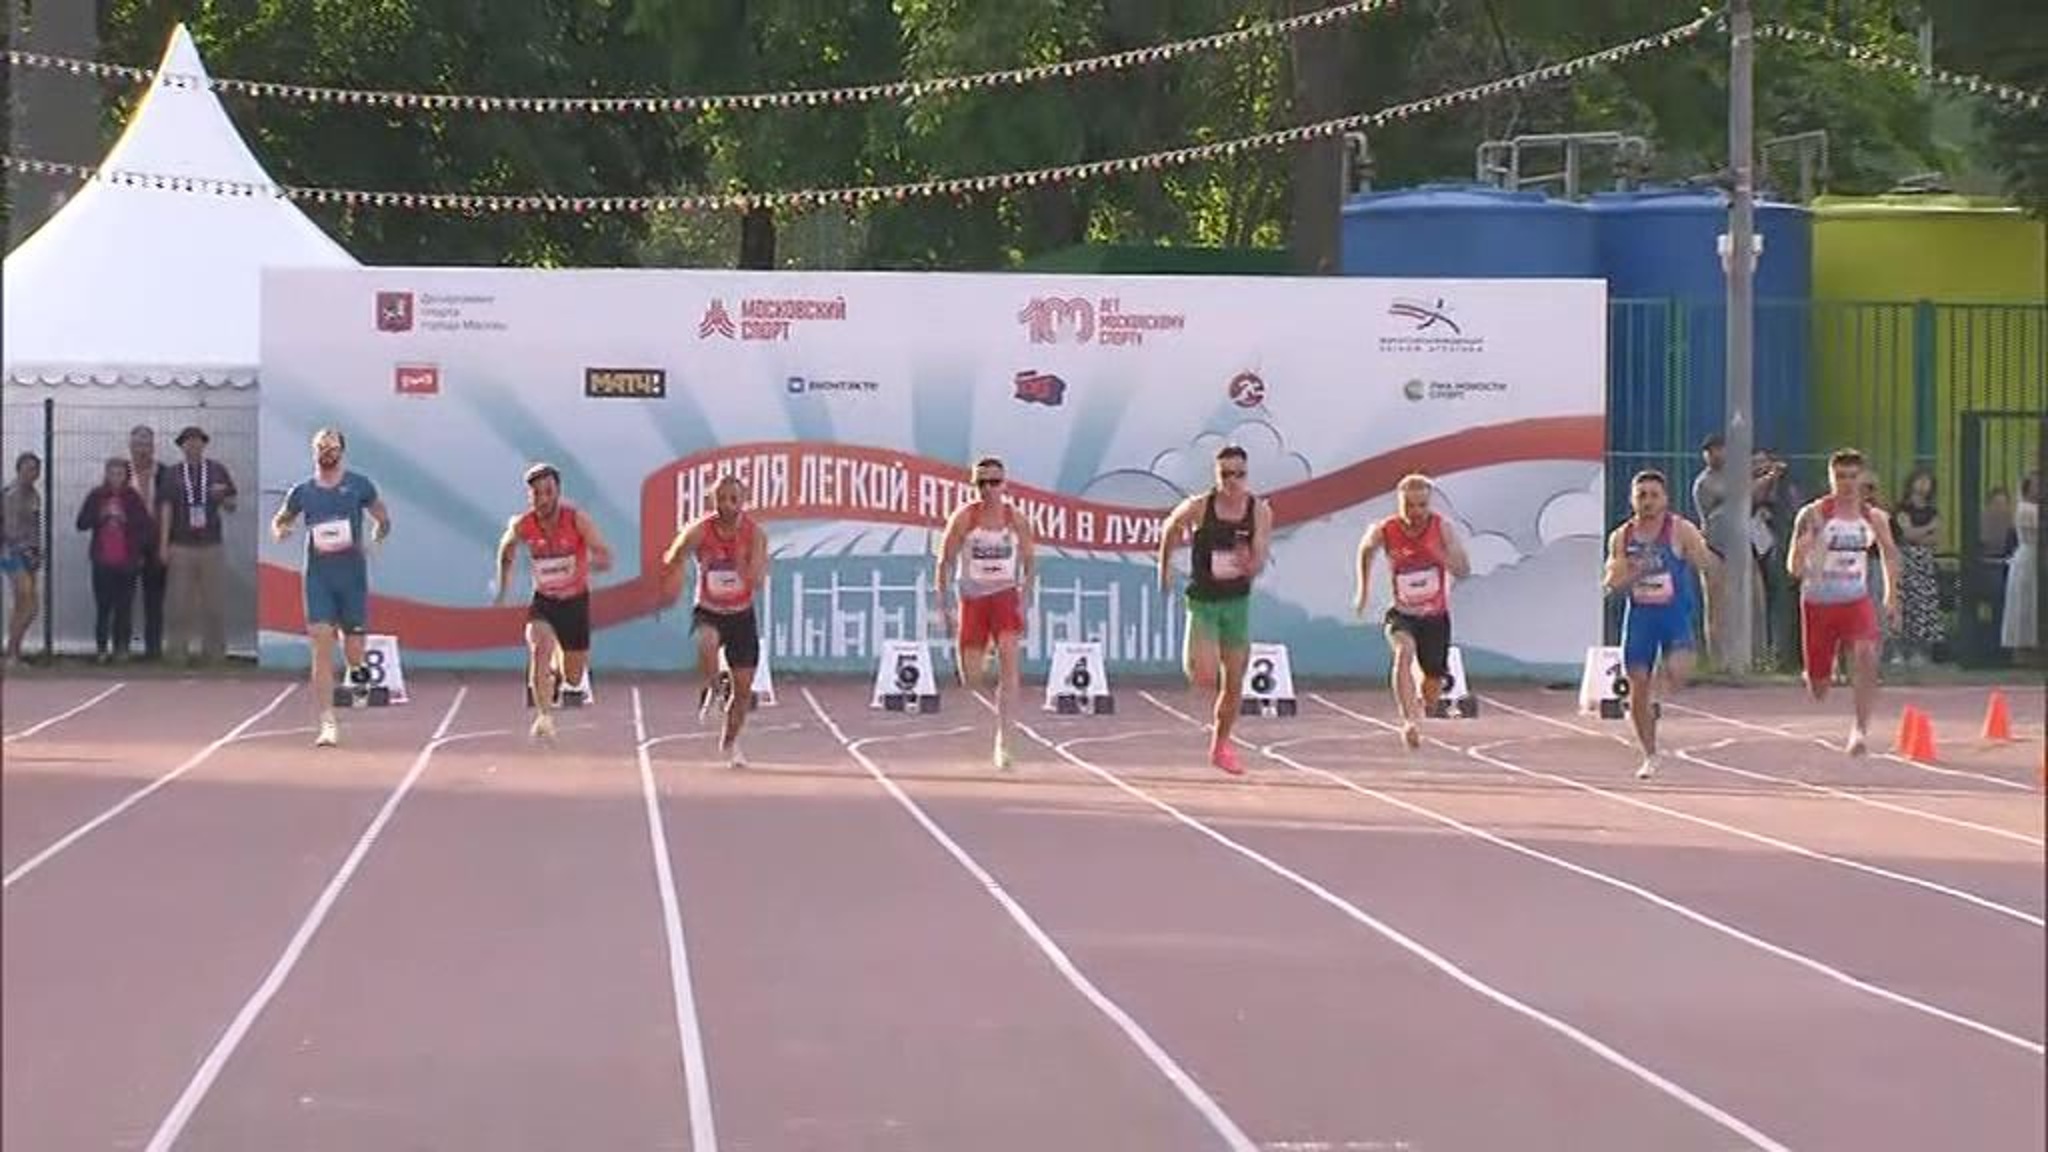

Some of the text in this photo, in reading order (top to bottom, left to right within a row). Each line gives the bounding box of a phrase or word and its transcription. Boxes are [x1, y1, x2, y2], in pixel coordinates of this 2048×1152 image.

[741, 296, 847, 320] МОСКОВСКИЙ
[1100, 298, 1120, 312] ЛЕТ
[741, 321, 790, 341] СПОРТ
[1100, 315, 1185, 329] МОСКОВСКОМУ
[799, 453, 909, 514] ЛЕГКОЙ
[1076, 511, 1094, 544] В
